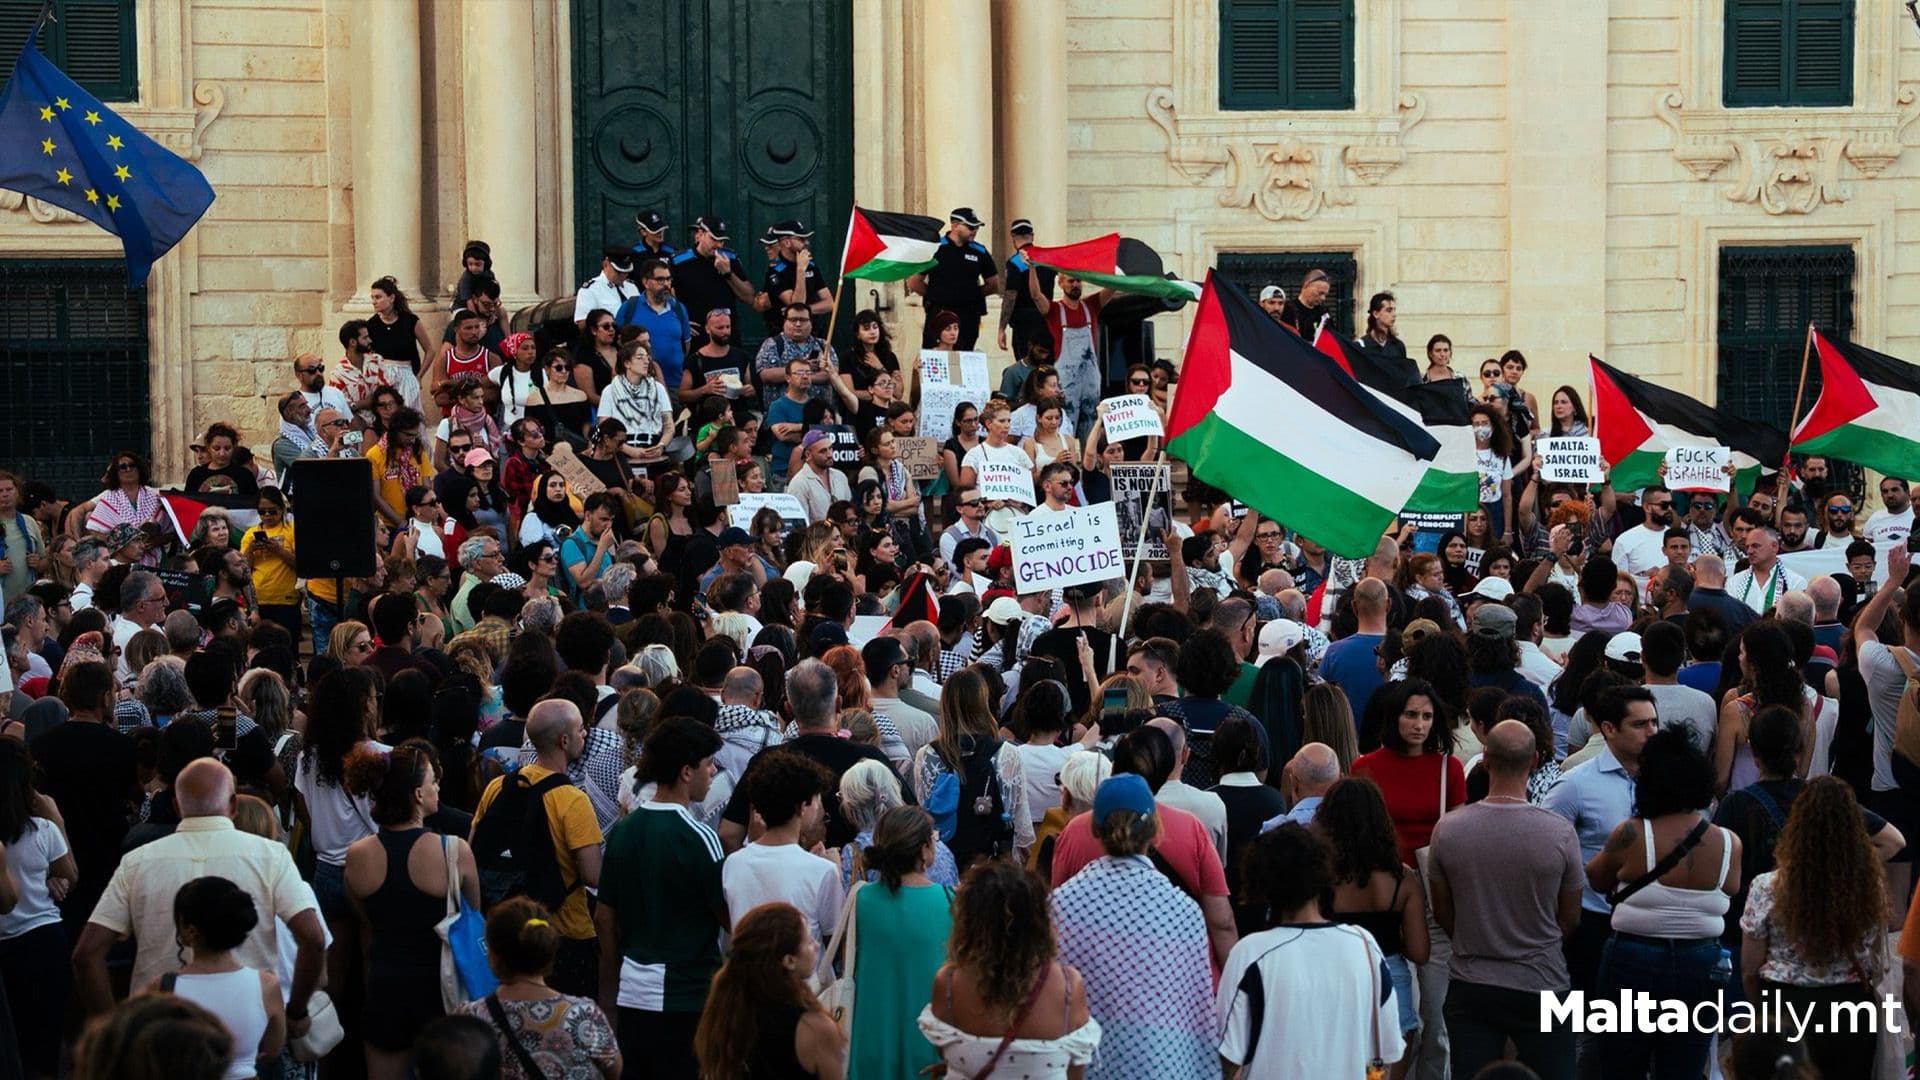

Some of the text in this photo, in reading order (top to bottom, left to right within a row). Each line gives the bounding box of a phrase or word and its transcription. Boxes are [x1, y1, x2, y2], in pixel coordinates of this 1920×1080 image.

[1110, 398, 1144, 411] STAND
[1106, 410, 1134, 424] WITH
[1109, 420, 1159, 434] PALESTINE
[838, 432, 855, 443] THE
[1550, 441, 1589, 451] MALTA:
[832, 450, 860, 461] OCIDE
[1545, 455, 1597, 465] SANCTION
[1676, 448, 1717, 464] FUCK
[989, 464, 1021, 475] STAND
[1112, 469, 1164, 477] NEVER AGAN
[1554, 469, 1589, 478] ISRAEL
[1114, 478, 1127, 491] IS
[985, 484, 1032, 498] PALESTINE
[1087, 513, 1100, 526] is
[1148, 549, 1170, 559] 2025
[1020, 549, 1120, 583] GENOCIDE
